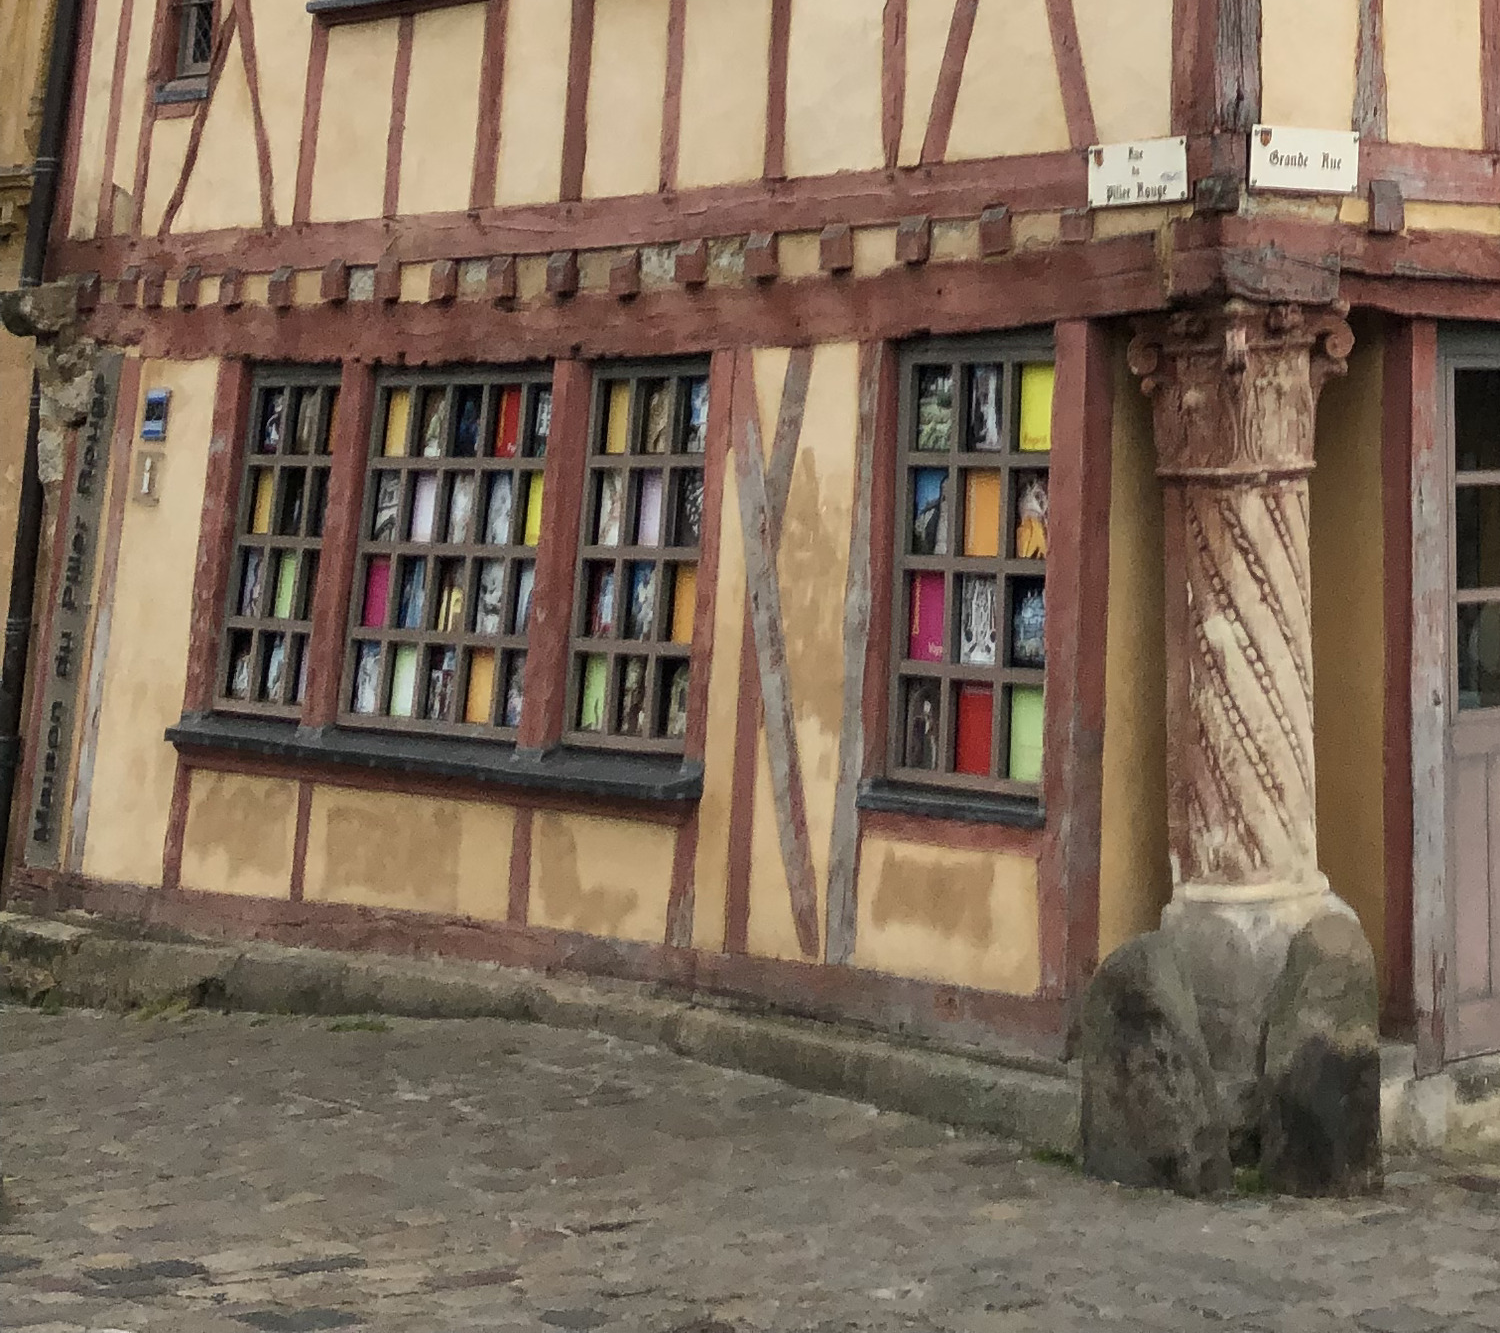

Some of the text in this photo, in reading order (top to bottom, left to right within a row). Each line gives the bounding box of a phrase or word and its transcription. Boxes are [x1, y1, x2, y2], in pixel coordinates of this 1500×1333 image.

[1128, 146, 1143, 161] Rue
[1269, 149, 1342, 170] Grande Rue
[1106, 181, 1167, 203] Pilier Rouge
[33, 373, 106, 842] Maison du Pilier Rouge
